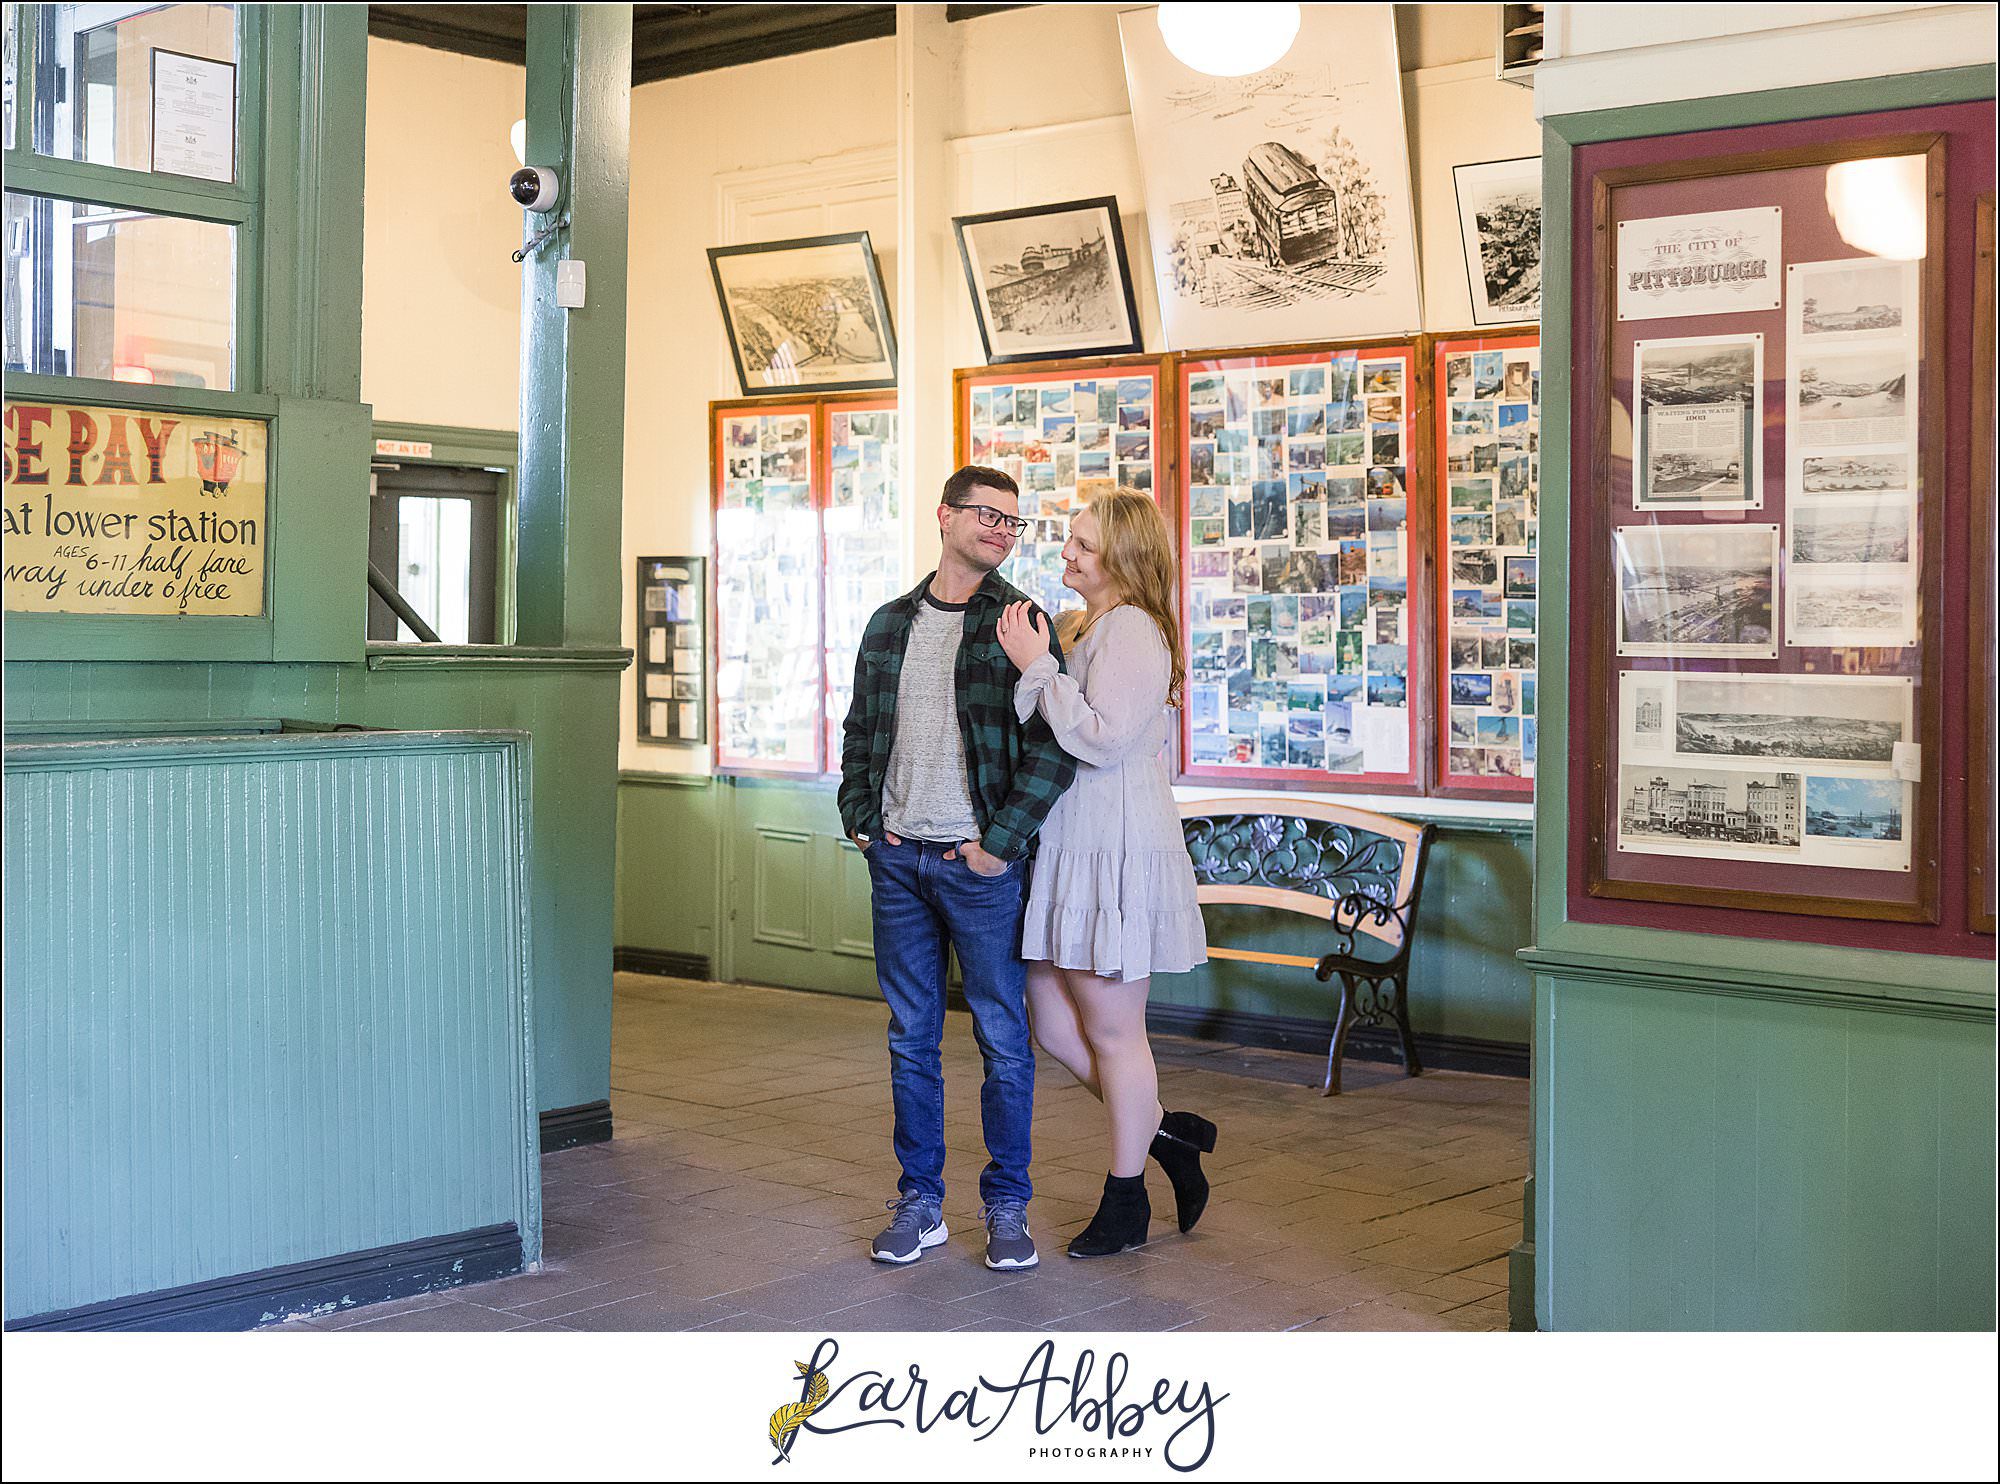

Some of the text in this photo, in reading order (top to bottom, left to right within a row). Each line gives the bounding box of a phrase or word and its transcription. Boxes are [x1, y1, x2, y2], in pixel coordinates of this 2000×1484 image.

[1654, 237, 1743, 255] THE CITY OF
[1628, 259, 1767, 292] PITTSBURGH
[65, 410, 181, 486] PAY
[45, 494, 138, 540] lower
[148, 509, 256, 545] station
[54, 544, 254, 583] AGES 6-11 half fare
[76, 571, 153, 598] under
[163, 581, 175, 598] 6
[177, 575, 232, 609] free
